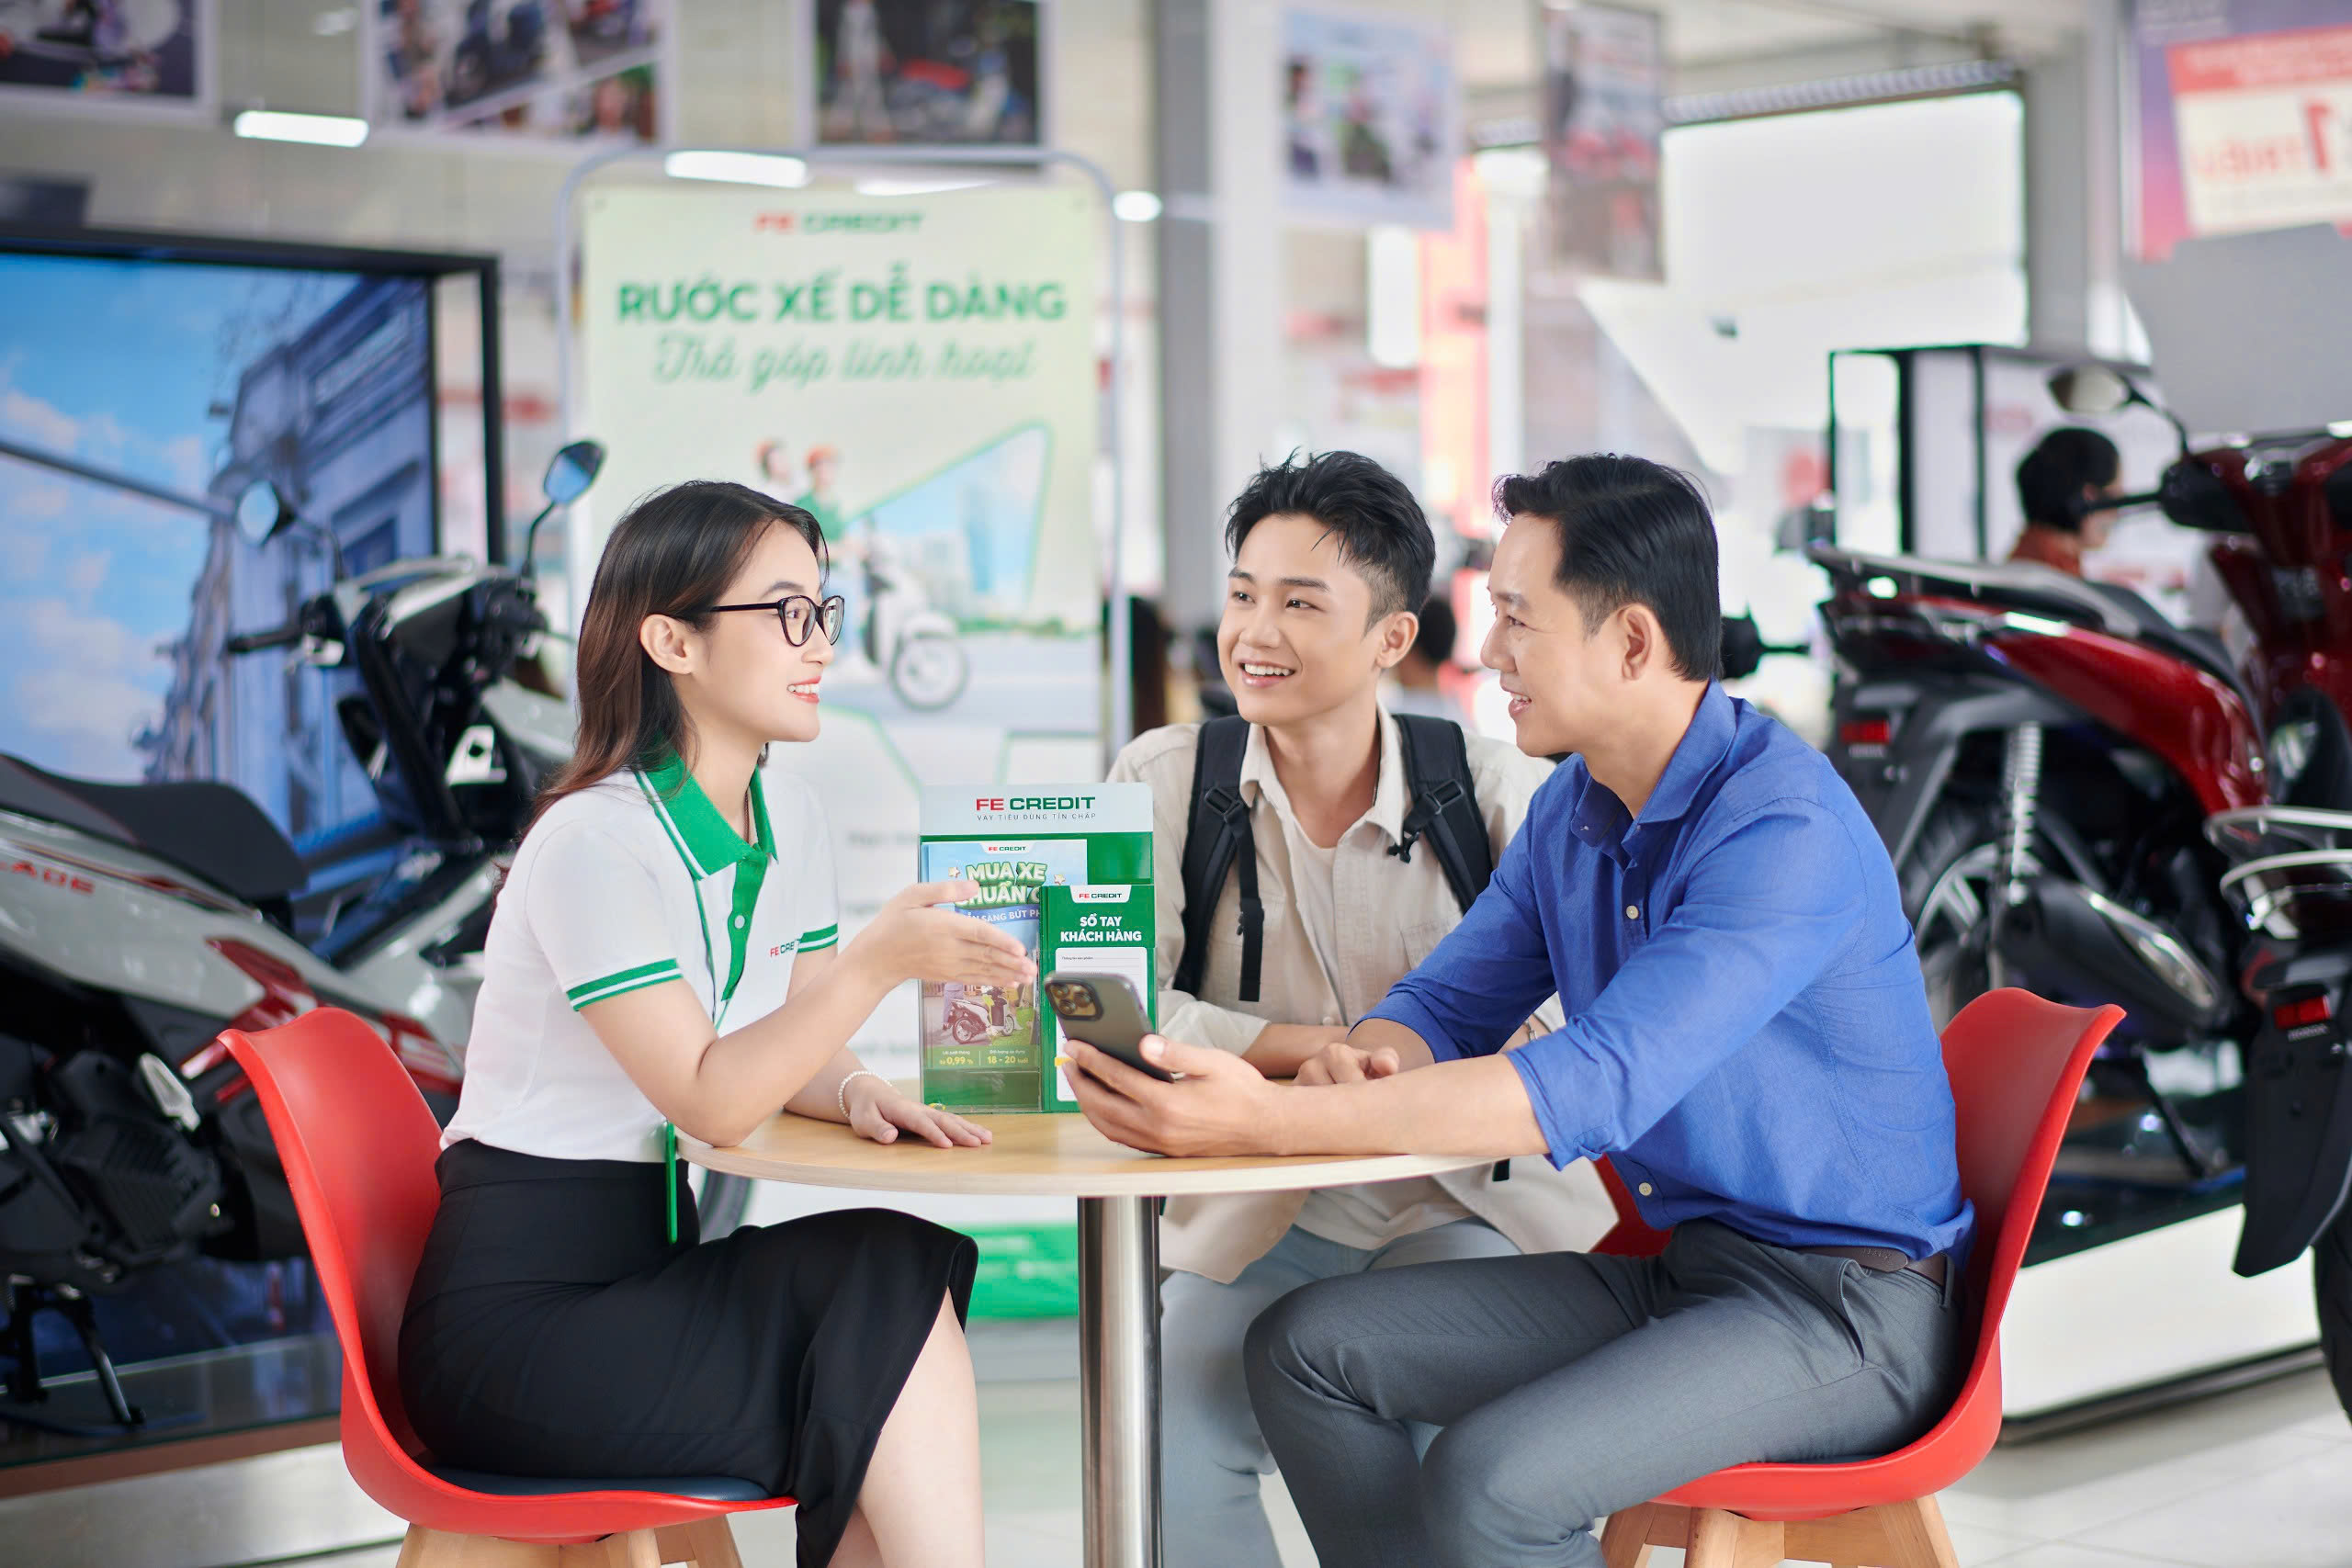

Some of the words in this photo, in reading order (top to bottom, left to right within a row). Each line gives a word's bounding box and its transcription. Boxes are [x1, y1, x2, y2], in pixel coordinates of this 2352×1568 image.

[924, 274, 1068, 321] DÀNG
[976, 798, 1004, 811] FE
[1009, 796, 1096, 810] CREDIT
[966, 862, 1015, 885] MUA
[1016, 862, 1047, 886] XE
[1100, 916, 1122, 927] TAY
[1060, 929, 1103, 942] KHÁCH
[1105, 929, 1142, 942] HÀNG
[770, 946, 779, 957] FE
[946, 1056, 966, 1065] 0,99
